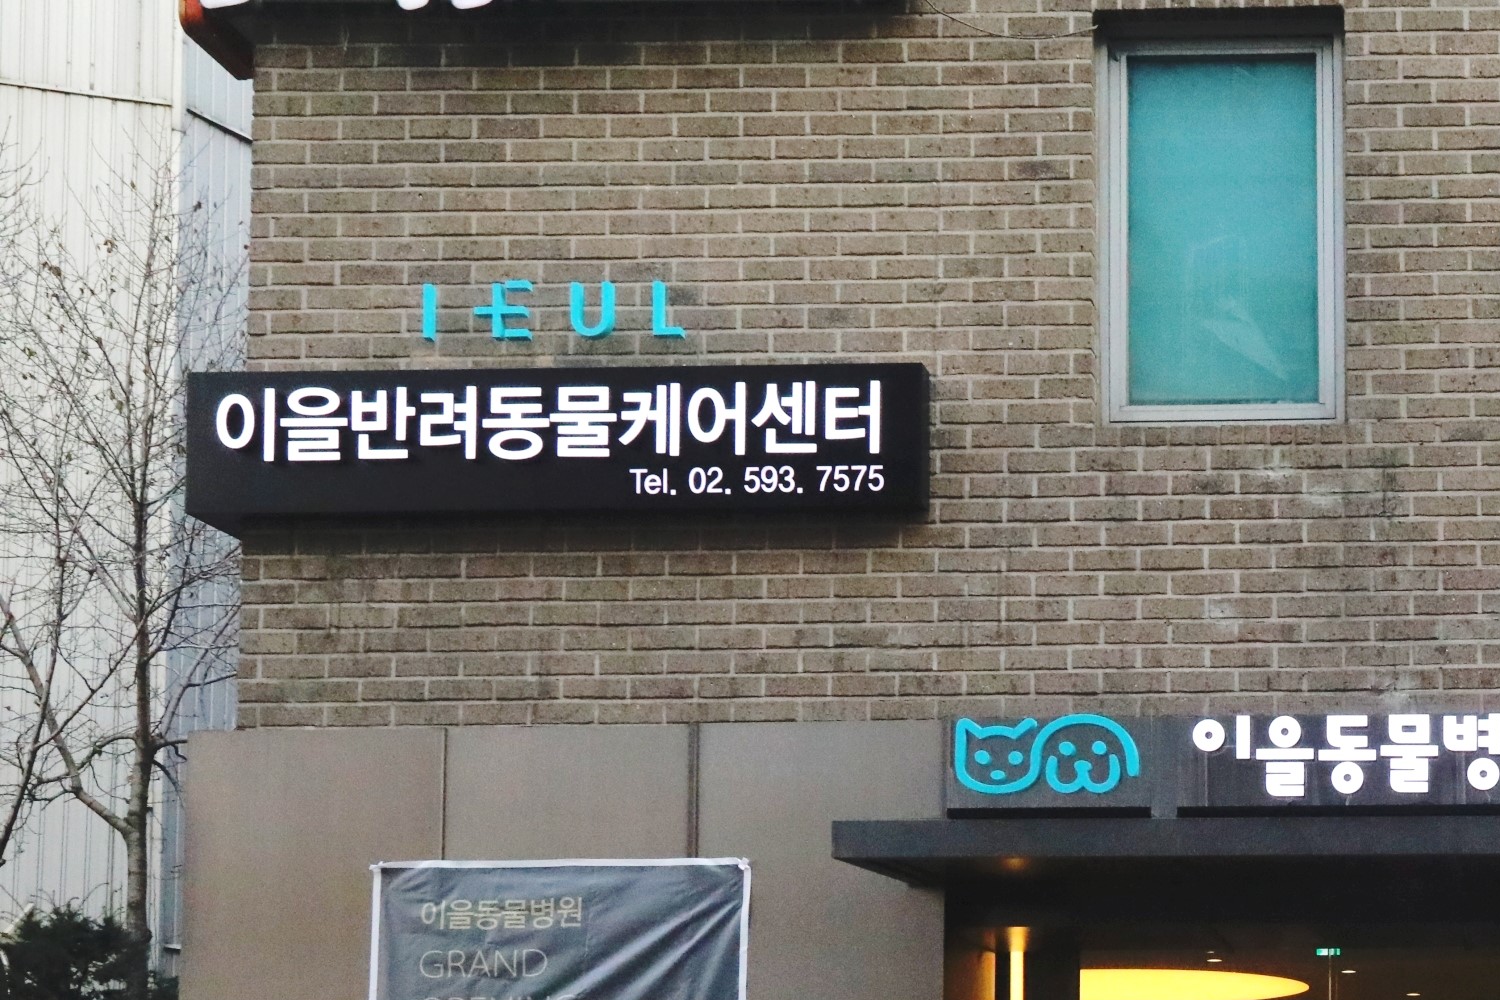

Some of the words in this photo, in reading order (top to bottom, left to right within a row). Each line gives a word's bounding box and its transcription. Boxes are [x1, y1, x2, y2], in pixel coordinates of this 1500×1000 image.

[422, 280, 685, 341] IEUL
[215, 380, 882, 463] 이을반려동물케어센터
[630, 468, 677, 496] Tel.
[688, 467, 732, 495] 02.
[744, 466, 804, 494] 593.
[816, 465, 885, 493] 7575
[420, 897, 582, 930] 이을동물병원
[419, 949, 548, 979] GRAND
